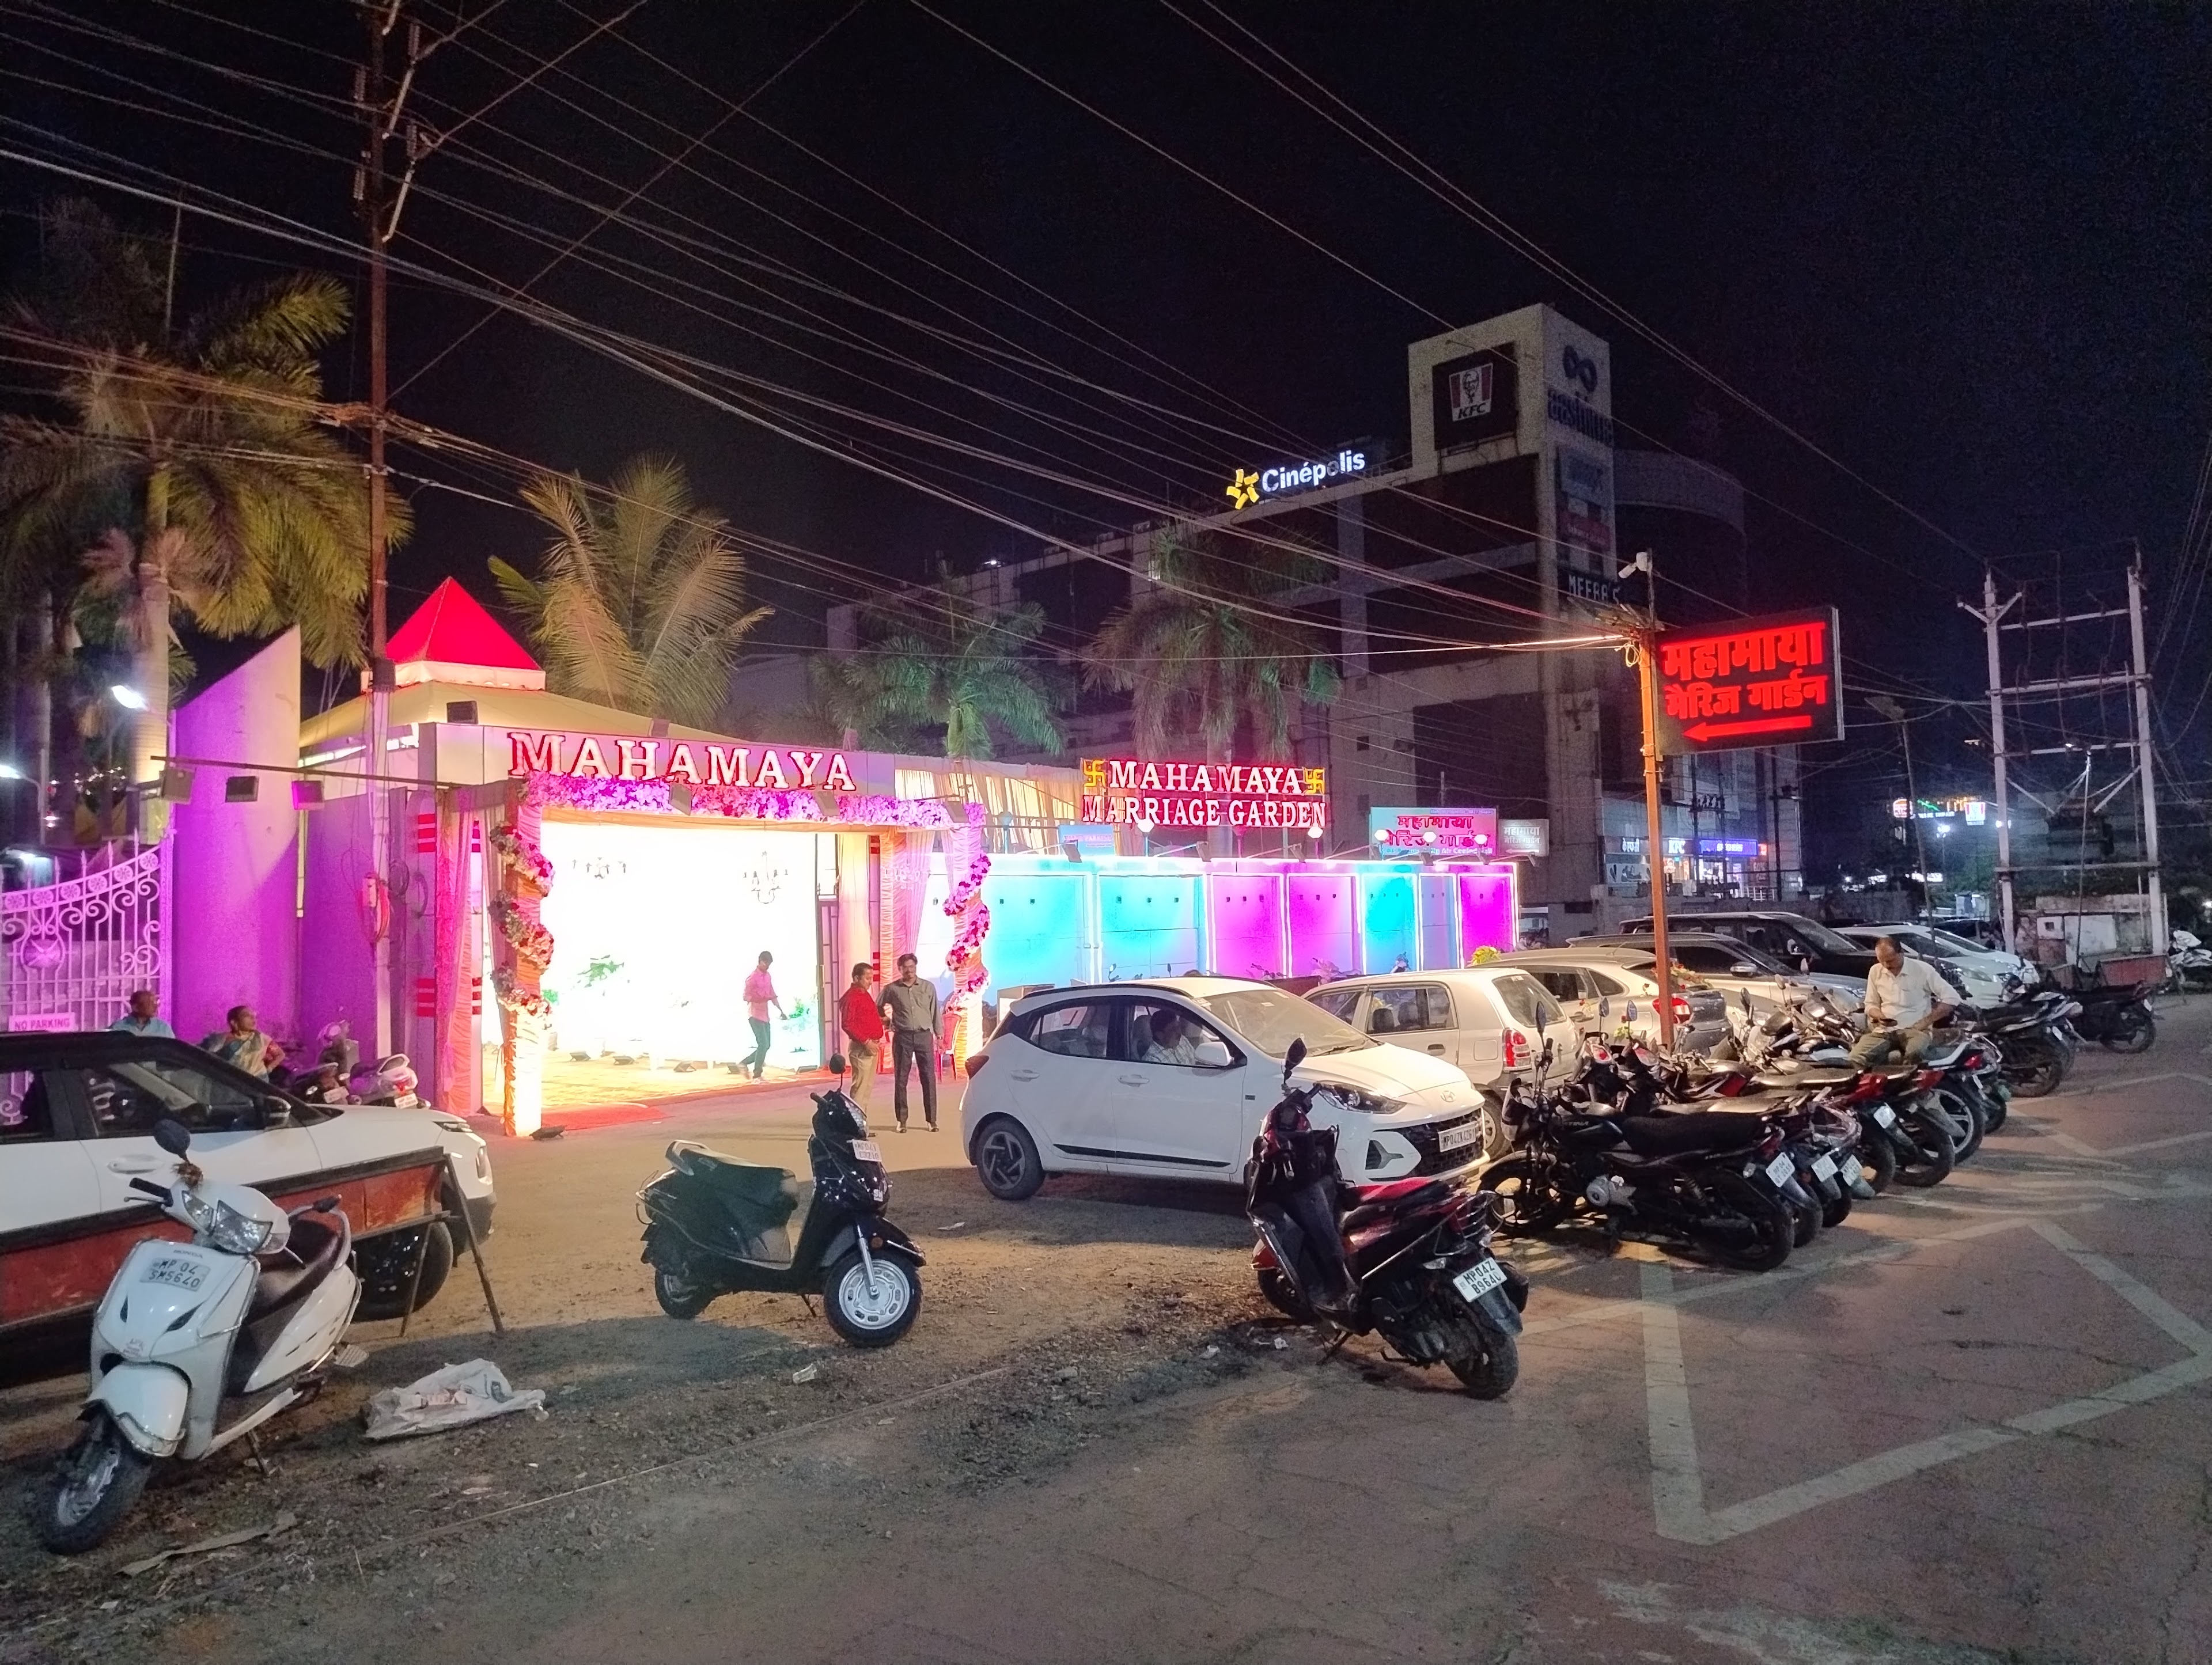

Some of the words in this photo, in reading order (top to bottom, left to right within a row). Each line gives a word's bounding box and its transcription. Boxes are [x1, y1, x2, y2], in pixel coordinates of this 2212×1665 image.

[1458, 403, 1486, 419] KFC
[1262, 450, 1366, 492] Cinépolis
[1661, 622, 1825, 681] महामाया
[507, 731, 857, 791] MAHAMAYA
[1108, 760, 1302, 794] MAHAMAYA
[1082, 795, 1221, 826] MARRIAGE
[1228, 799, 1327, 828] GARDEN
[1397, 816, 1474, 830] महामाया
[1503, 826, 1540, 836] महामाया
[1668, 840, 1685, 854] KFC
[14, 1021, 28, 1030] NO
[31, 1018, 70, 1029] PARKING
[1463, 1261, 1495, 1285] MP04Z
